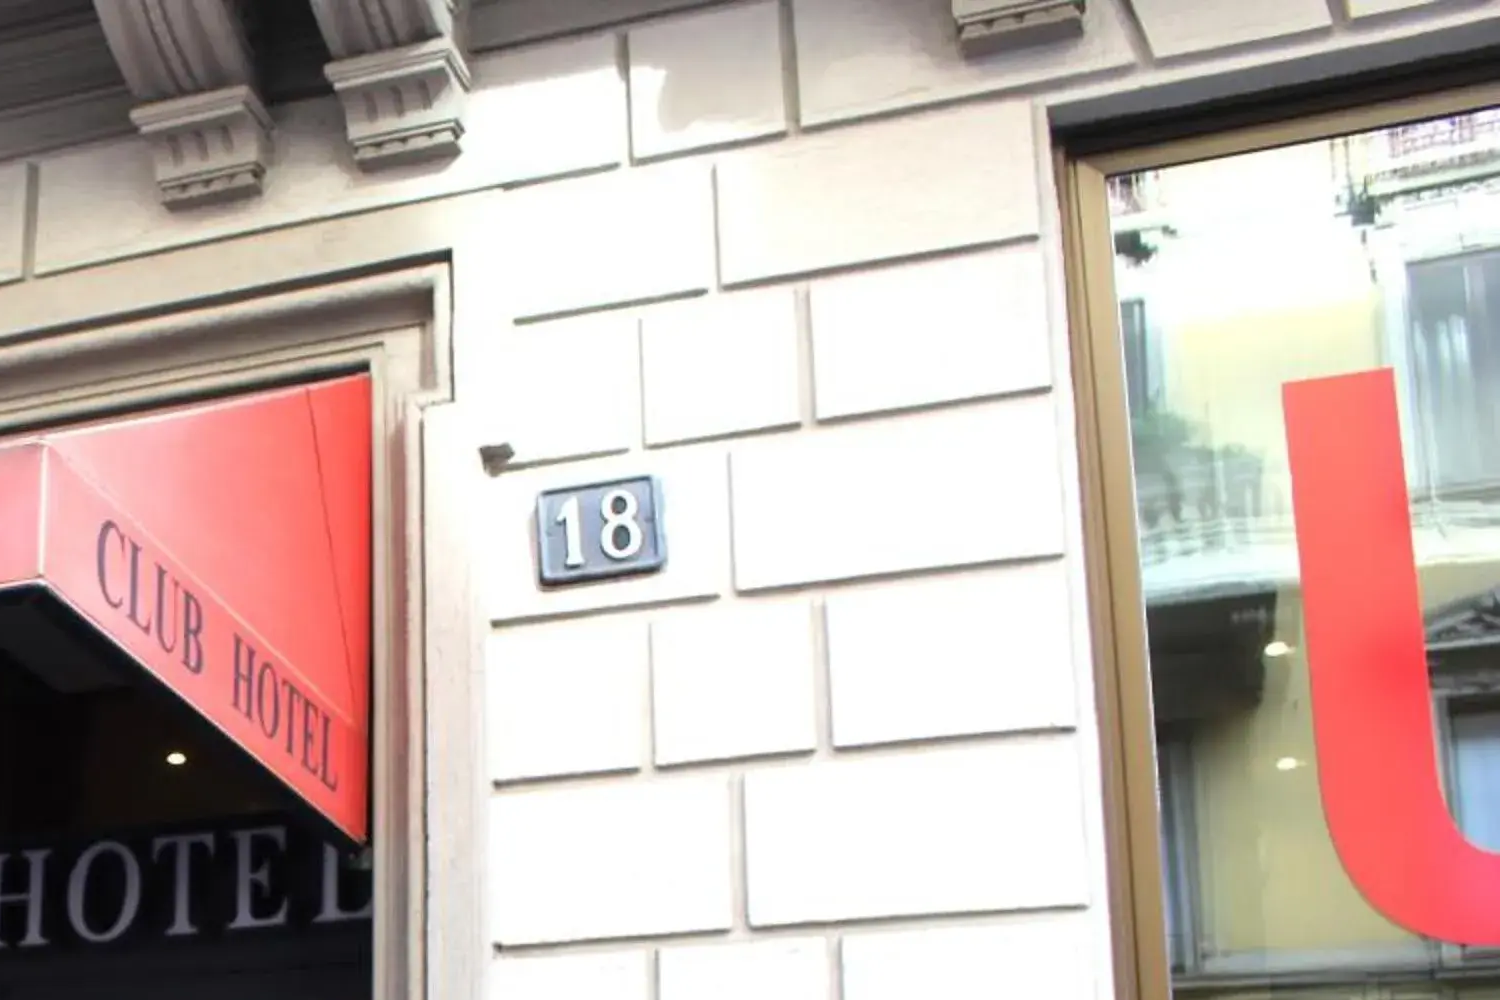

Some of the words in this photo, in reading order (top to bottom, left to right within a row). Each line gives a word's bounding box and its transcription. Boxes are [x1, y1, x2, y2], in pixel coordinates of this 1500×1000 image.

[556, 489, 643, 566] 18
[96, 519, 203, 675] CLUB
[232, 632, 337, 792] HOTEL
